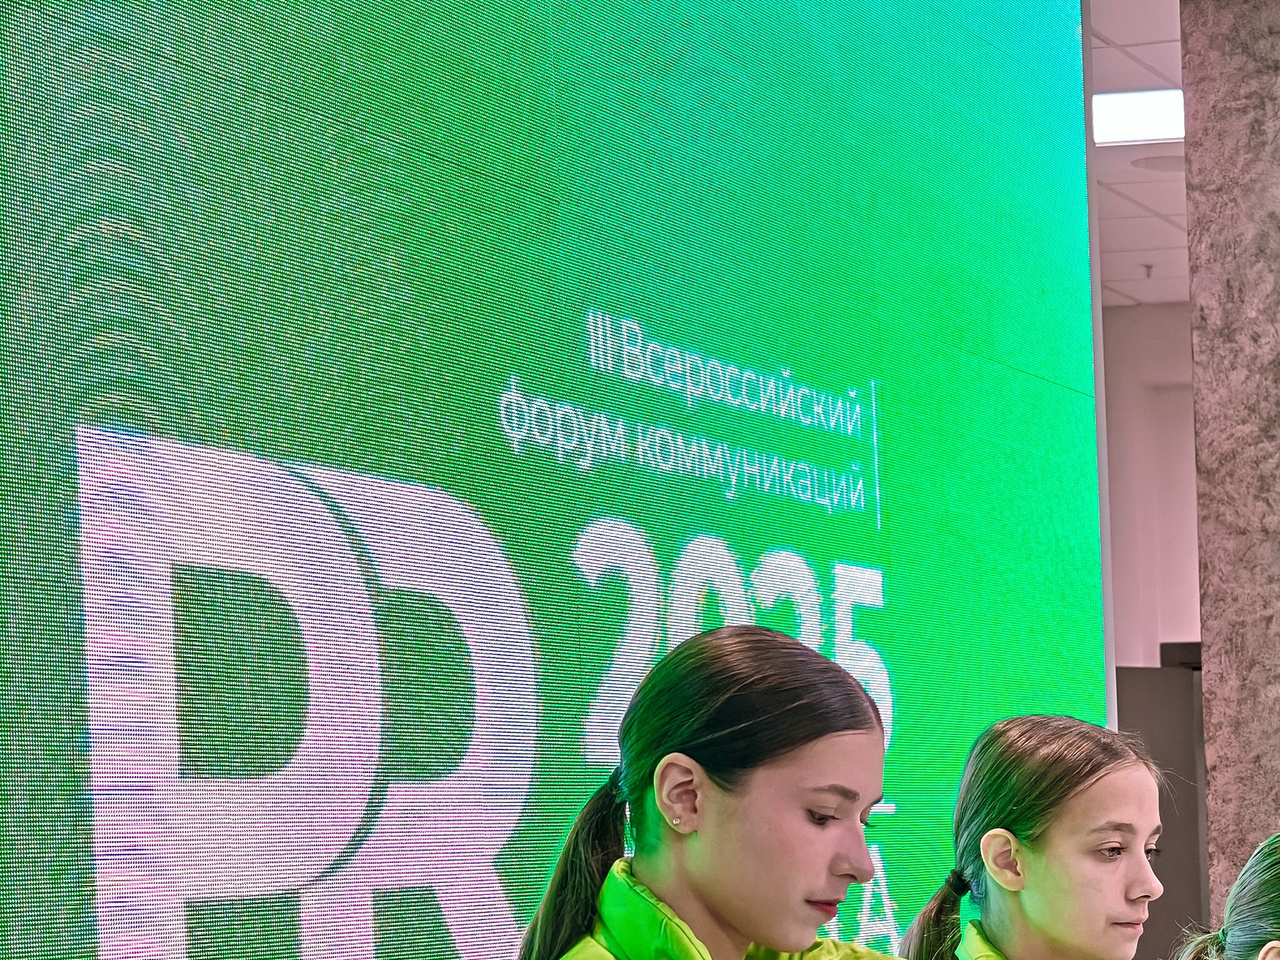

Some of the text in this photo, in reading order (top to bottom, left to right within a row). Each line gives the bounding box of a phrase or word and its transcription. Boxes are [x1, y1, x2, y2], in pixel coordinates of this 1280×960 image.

[620, 316, 862, 438] Всероссийский
[499, 374, 866, 515] форум коммуникаций
